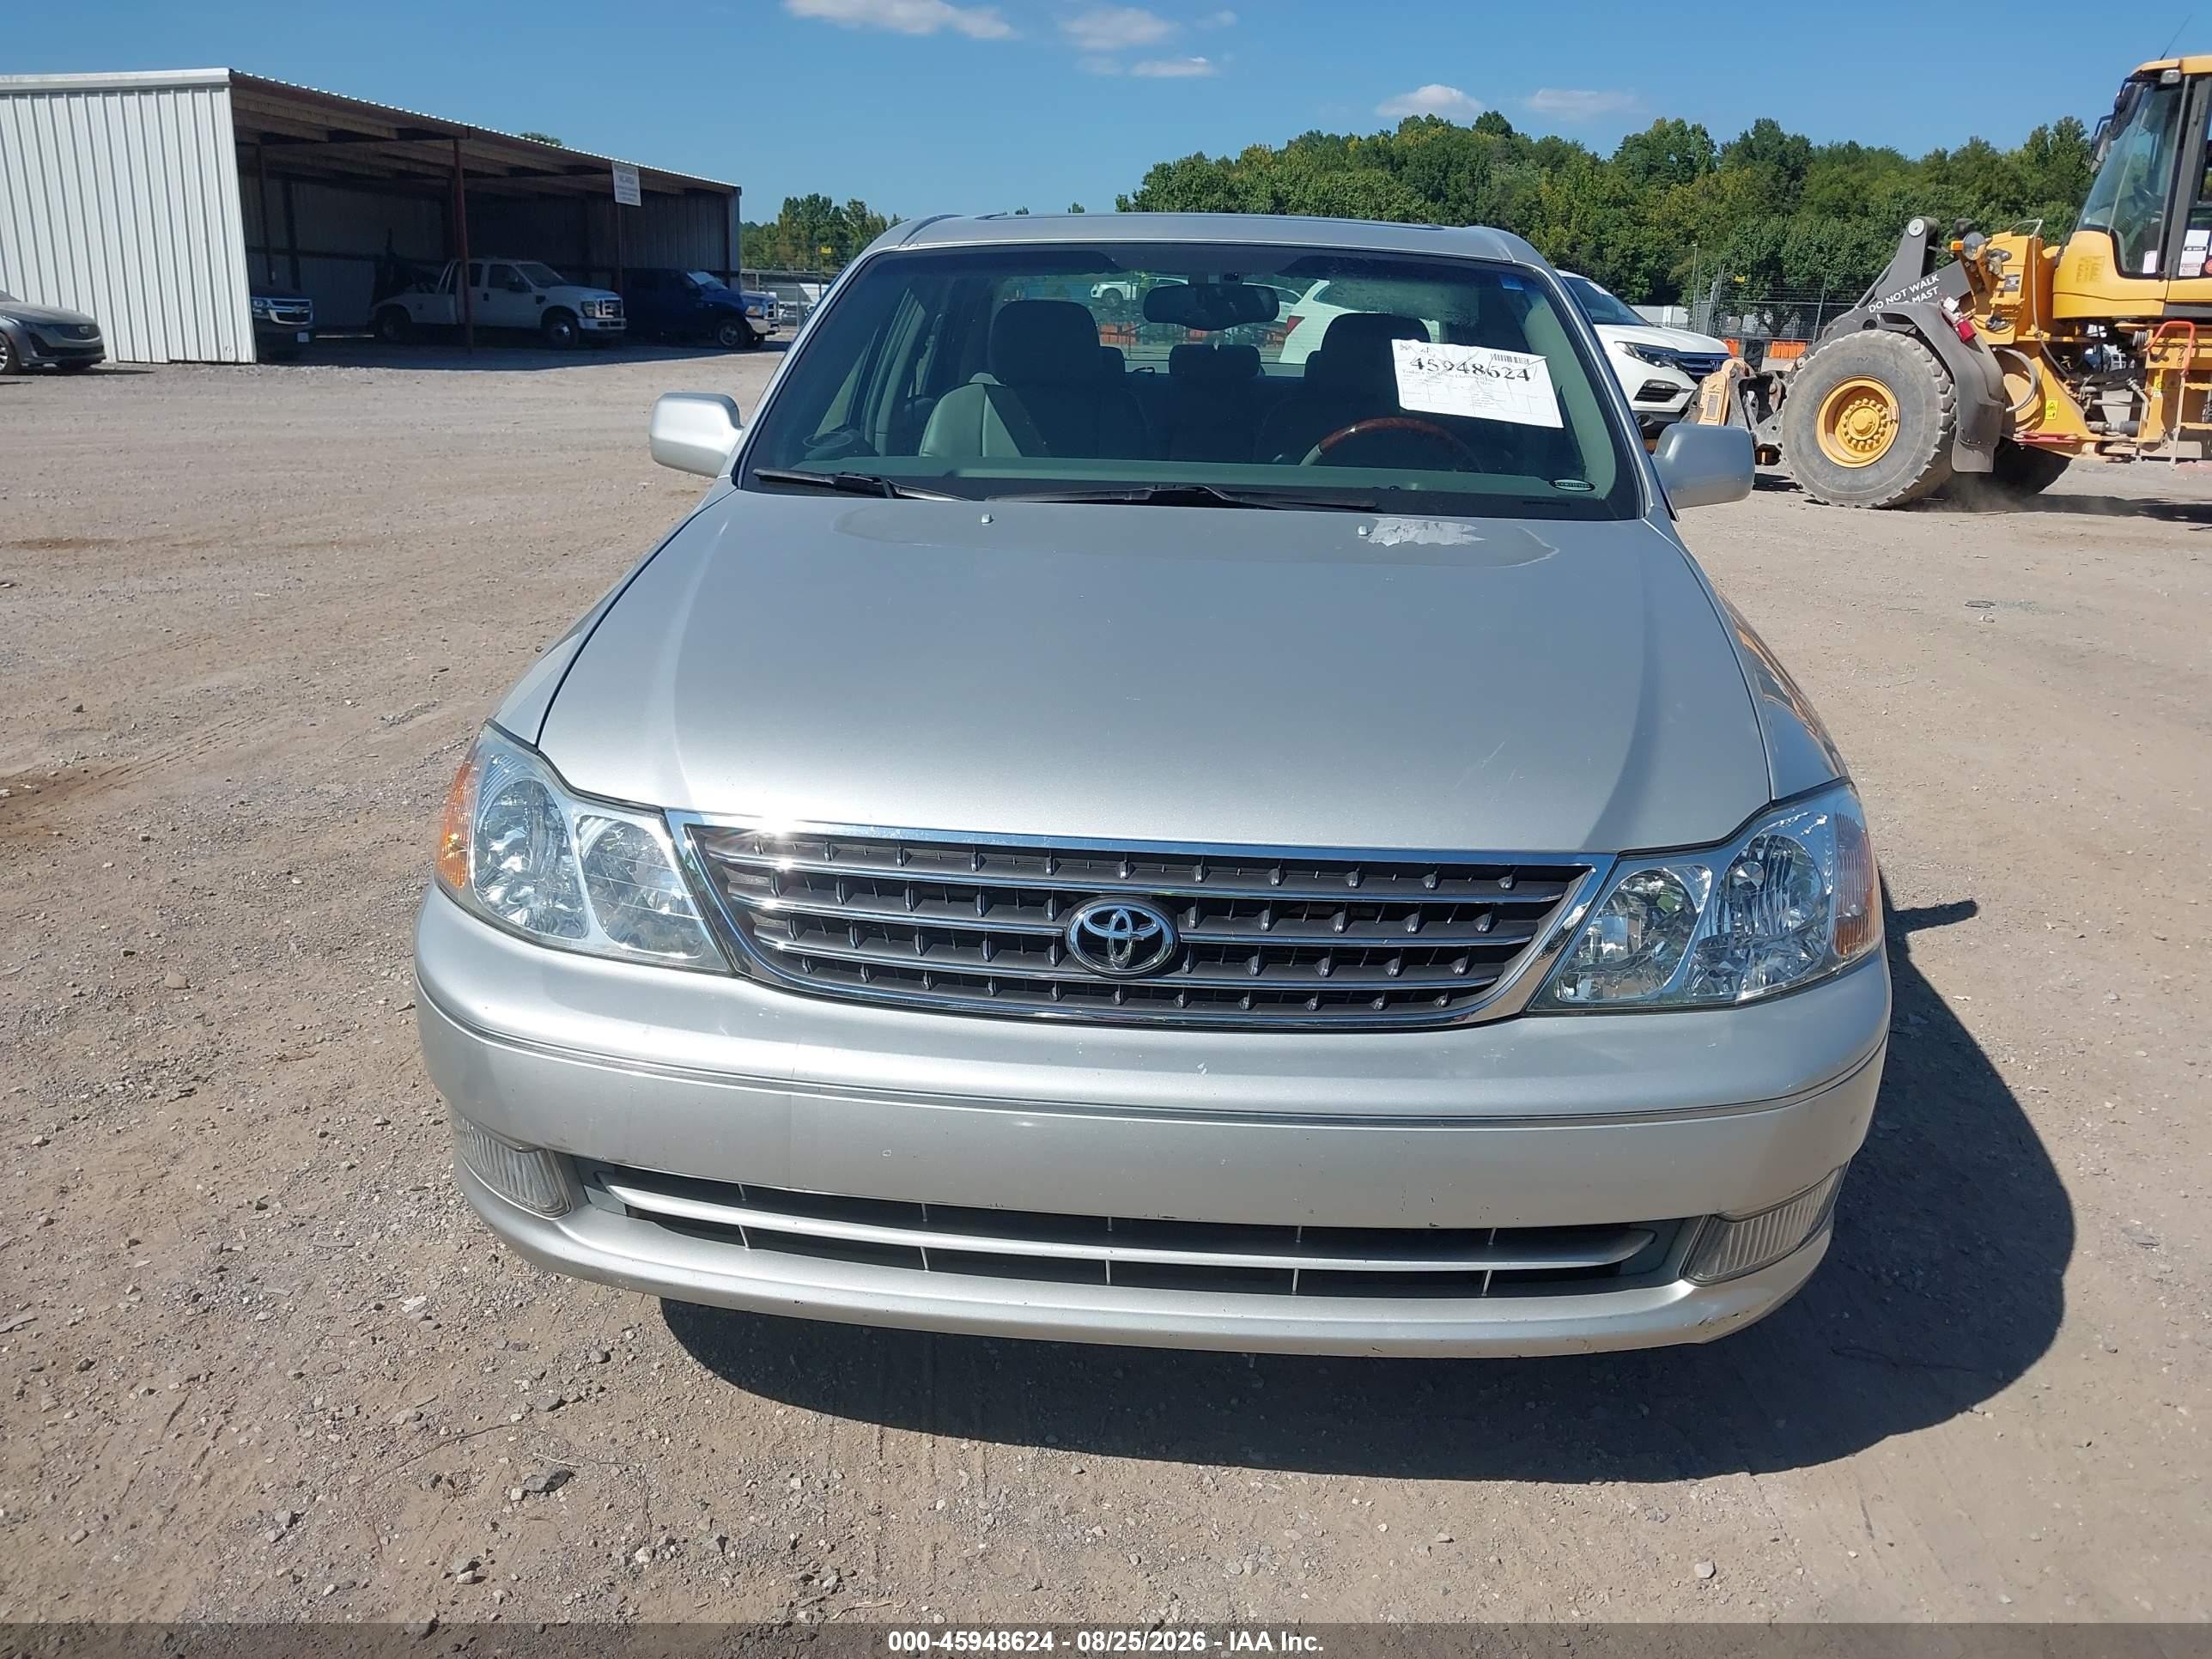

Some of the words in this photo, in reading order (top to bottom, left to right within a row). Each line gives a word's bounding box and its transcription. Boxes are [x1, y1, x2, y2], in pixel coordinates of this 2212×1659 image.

[1868, 301, 1884, 313] DO
[1885, 289, 1907, 306] NOT
[1908, 274, 1941, 294] WALK
[1911, 286, 1939, 303] MAST
[1409, 357, 1531, 382] 45948624
